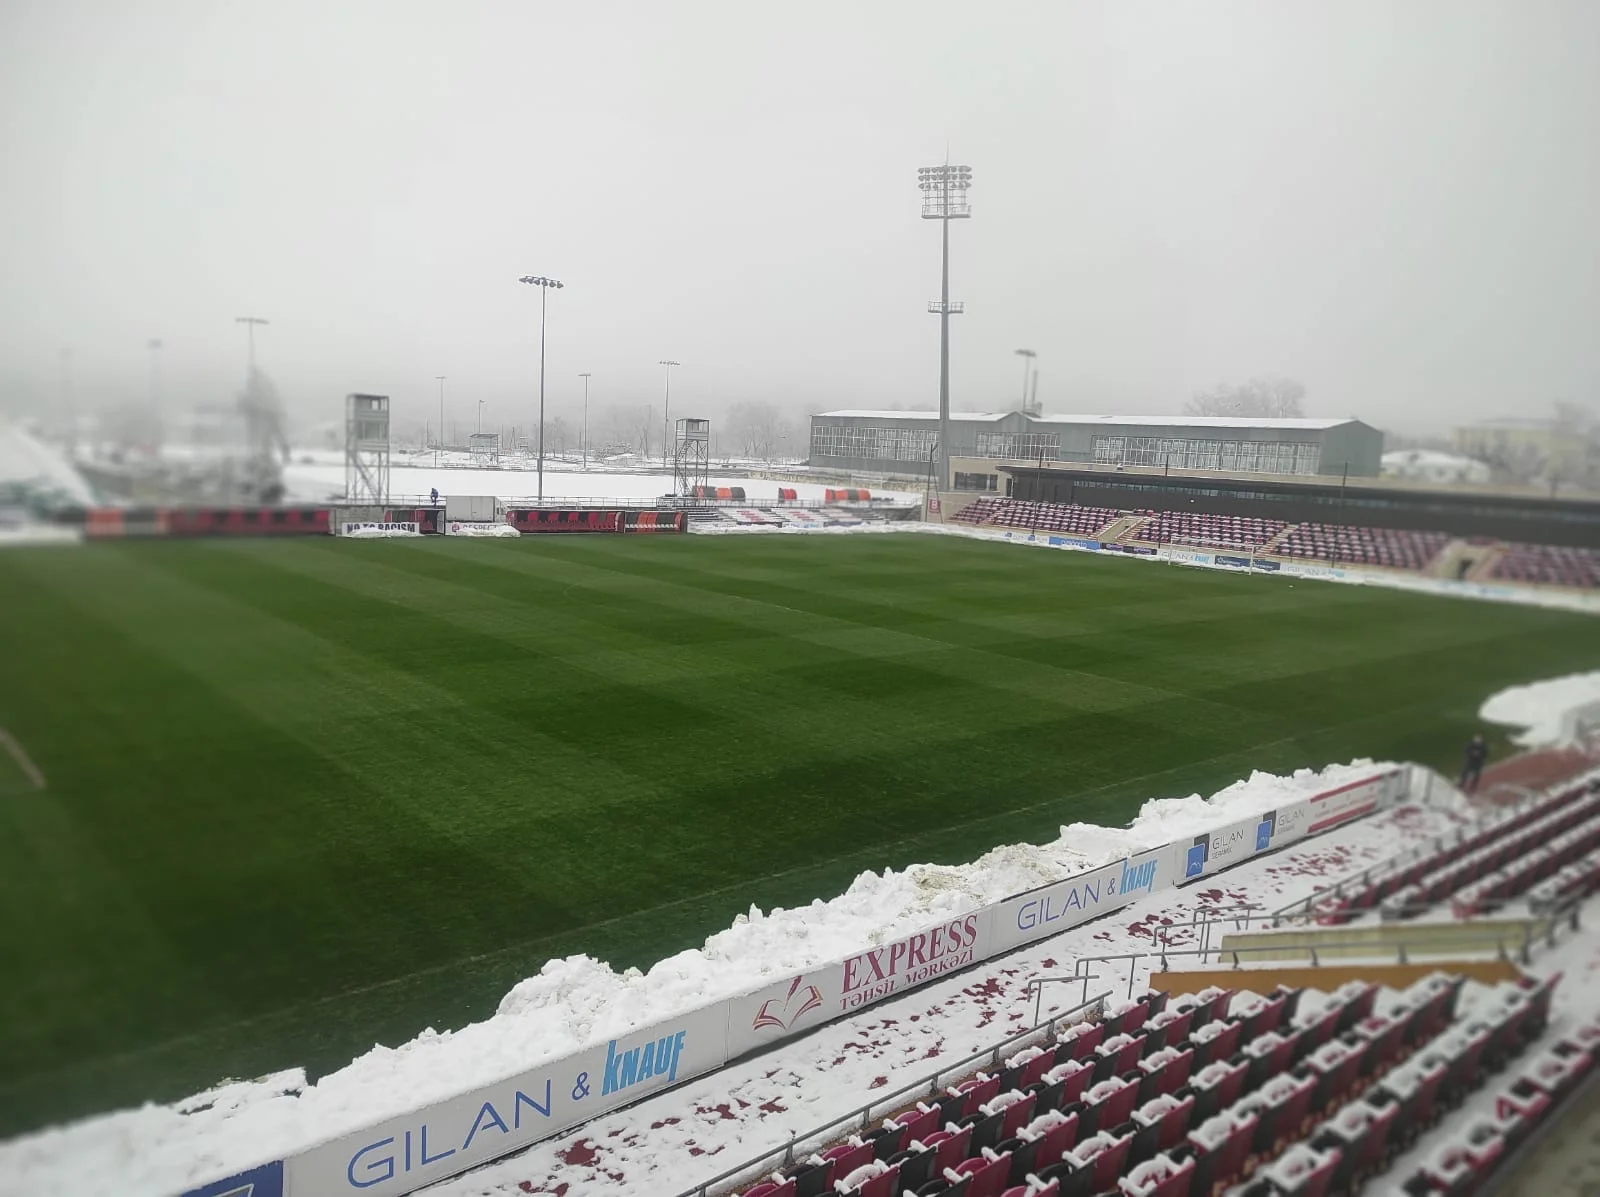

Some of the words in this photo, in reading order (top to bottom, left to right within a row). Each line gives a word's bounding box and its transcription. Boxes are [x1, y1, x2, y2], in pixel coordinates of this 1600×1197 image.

[378, 523, 416, 533] RACISM
[1212, 829, 1244, 850] GILAN
[1017, 879, 1101, 930] GILAN
[1107, 878, 1116, 896] &
[1119, 859, 1158, 896] KNAUF
[840, 913, 978, 995] EXPRESS
[346, 1078, 552, 1189] GILAN
[571, 1071, 590, 1101] &
[601, 1030, 687, 1098] KNAUF
